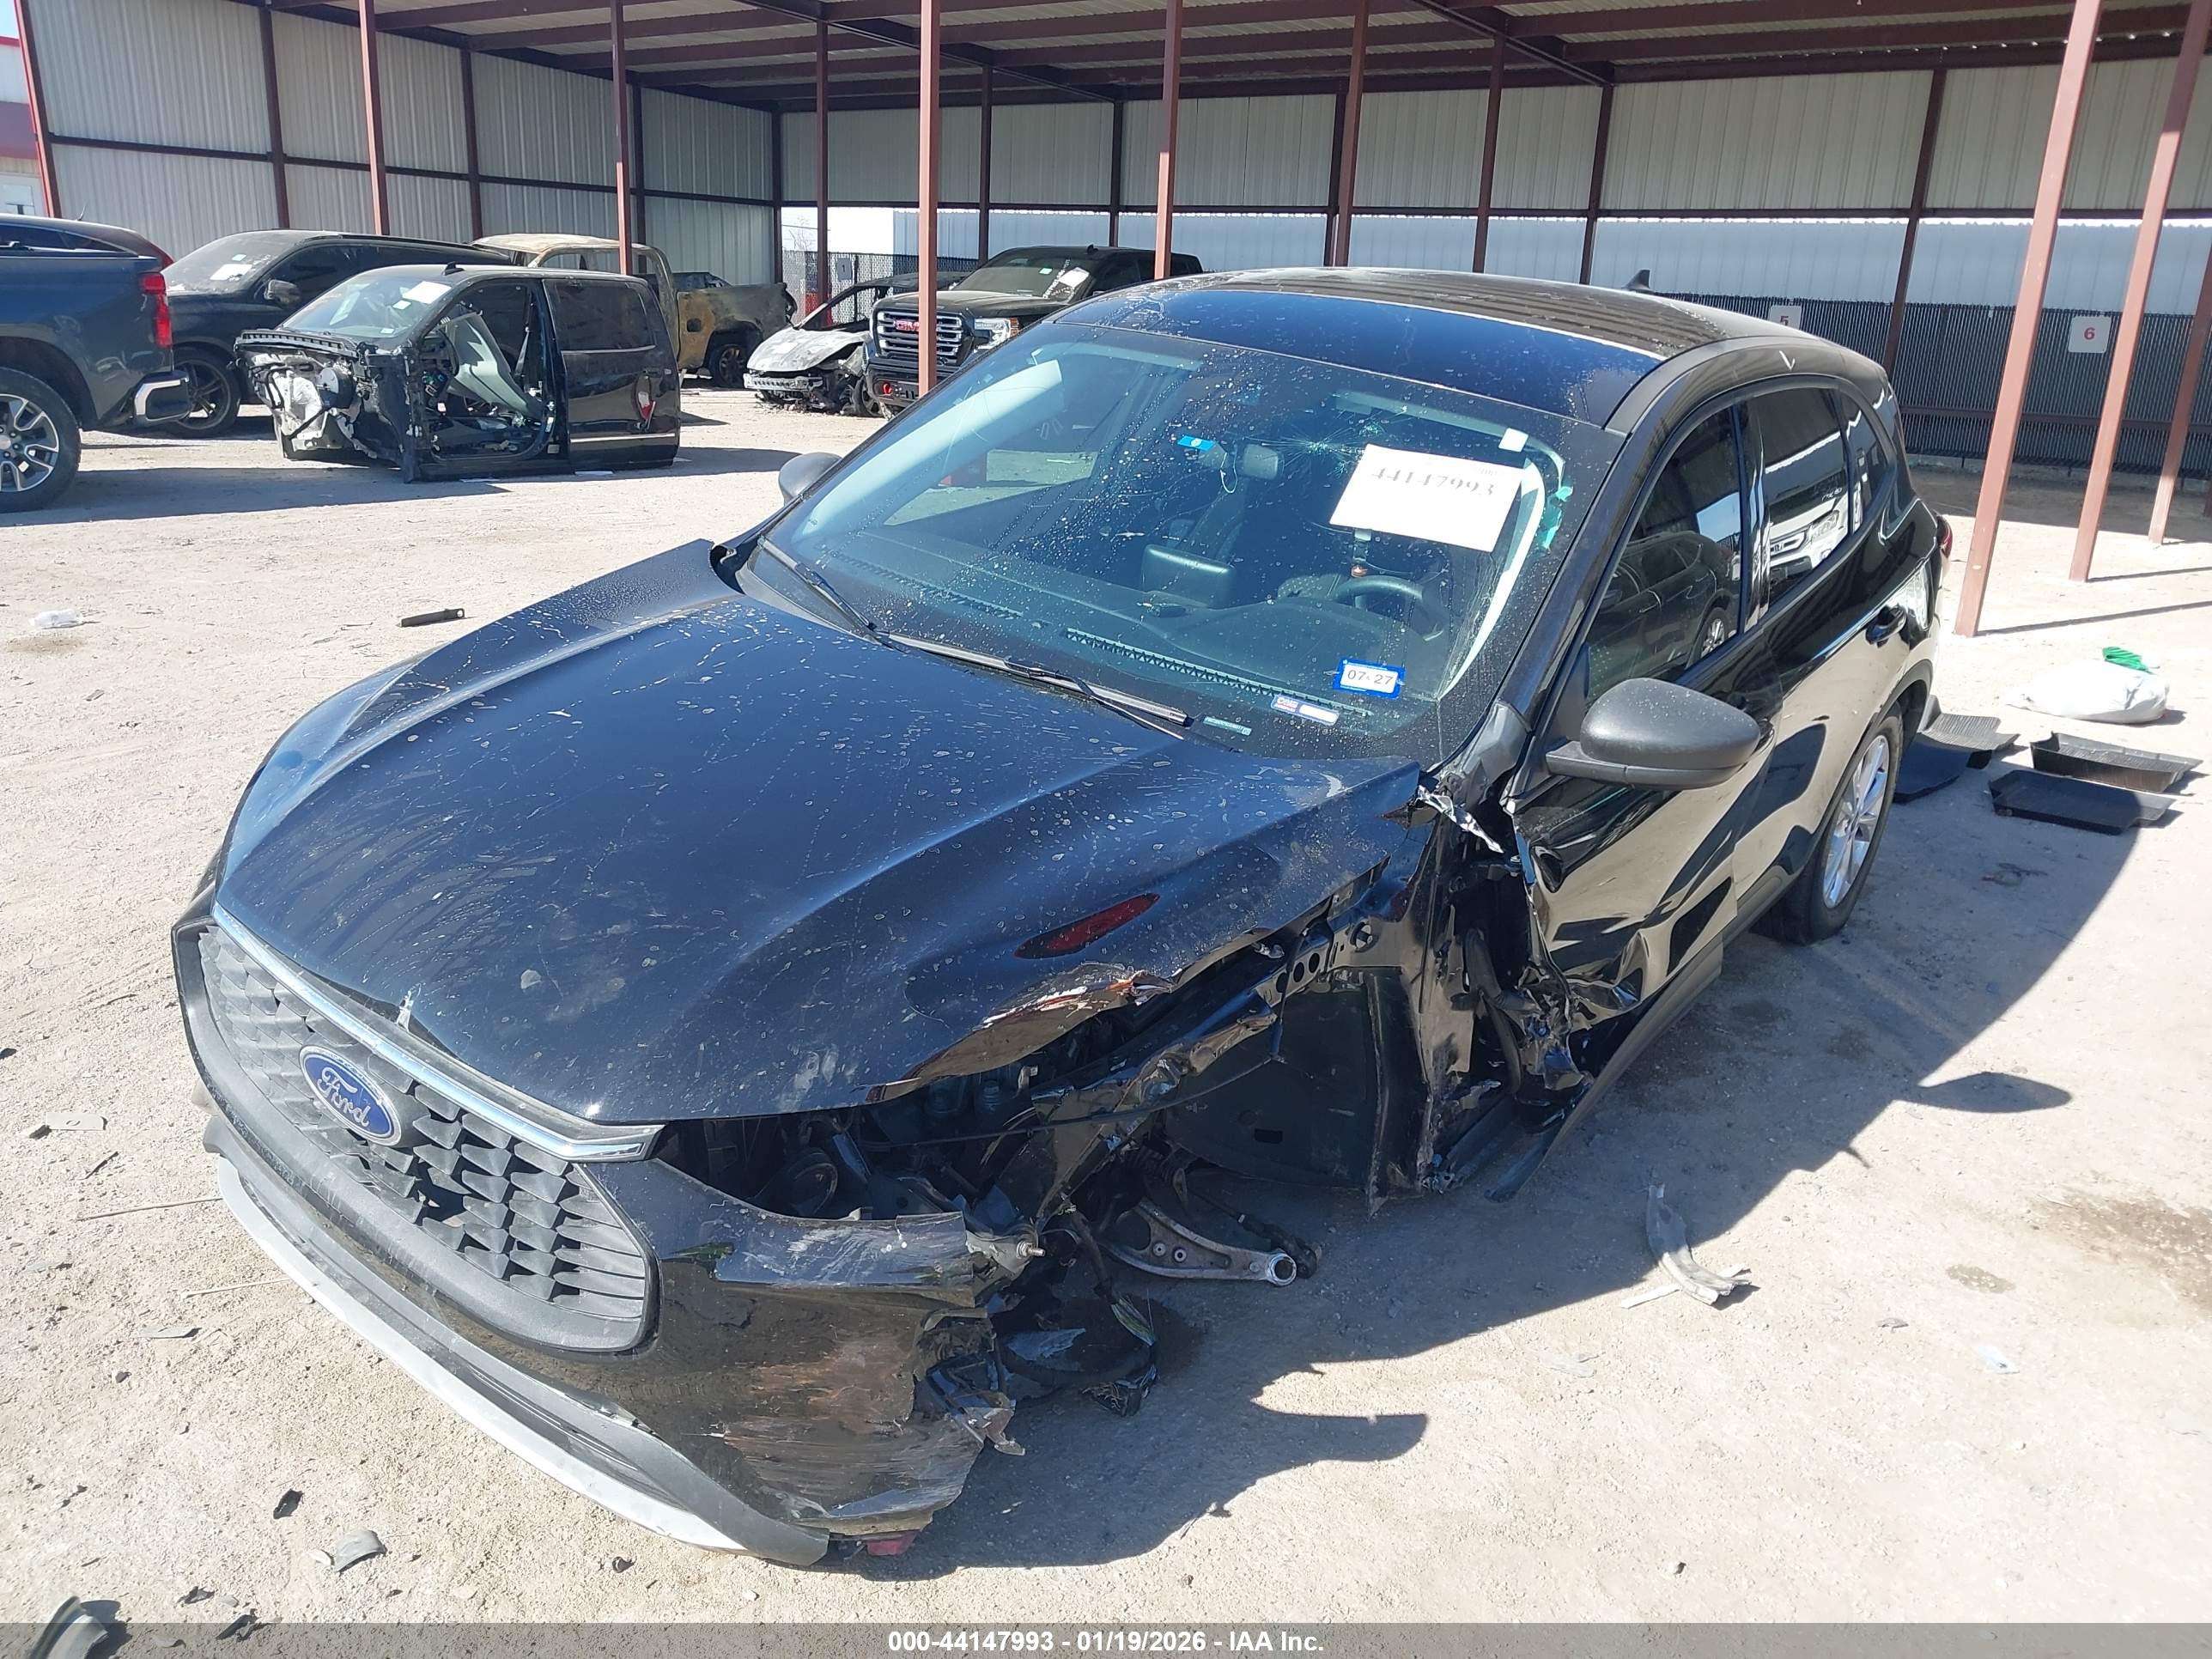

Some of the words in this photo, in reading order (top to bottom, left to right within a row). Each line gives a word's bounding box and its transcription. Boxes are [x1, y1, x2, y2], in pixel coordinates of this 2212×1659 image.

[894, 319, 920, 332] GM
[1779, 315, 1790, 326] 5
[2083, 327, 2096, 341] 6
[316, 1066, 372, 1127] Ford
